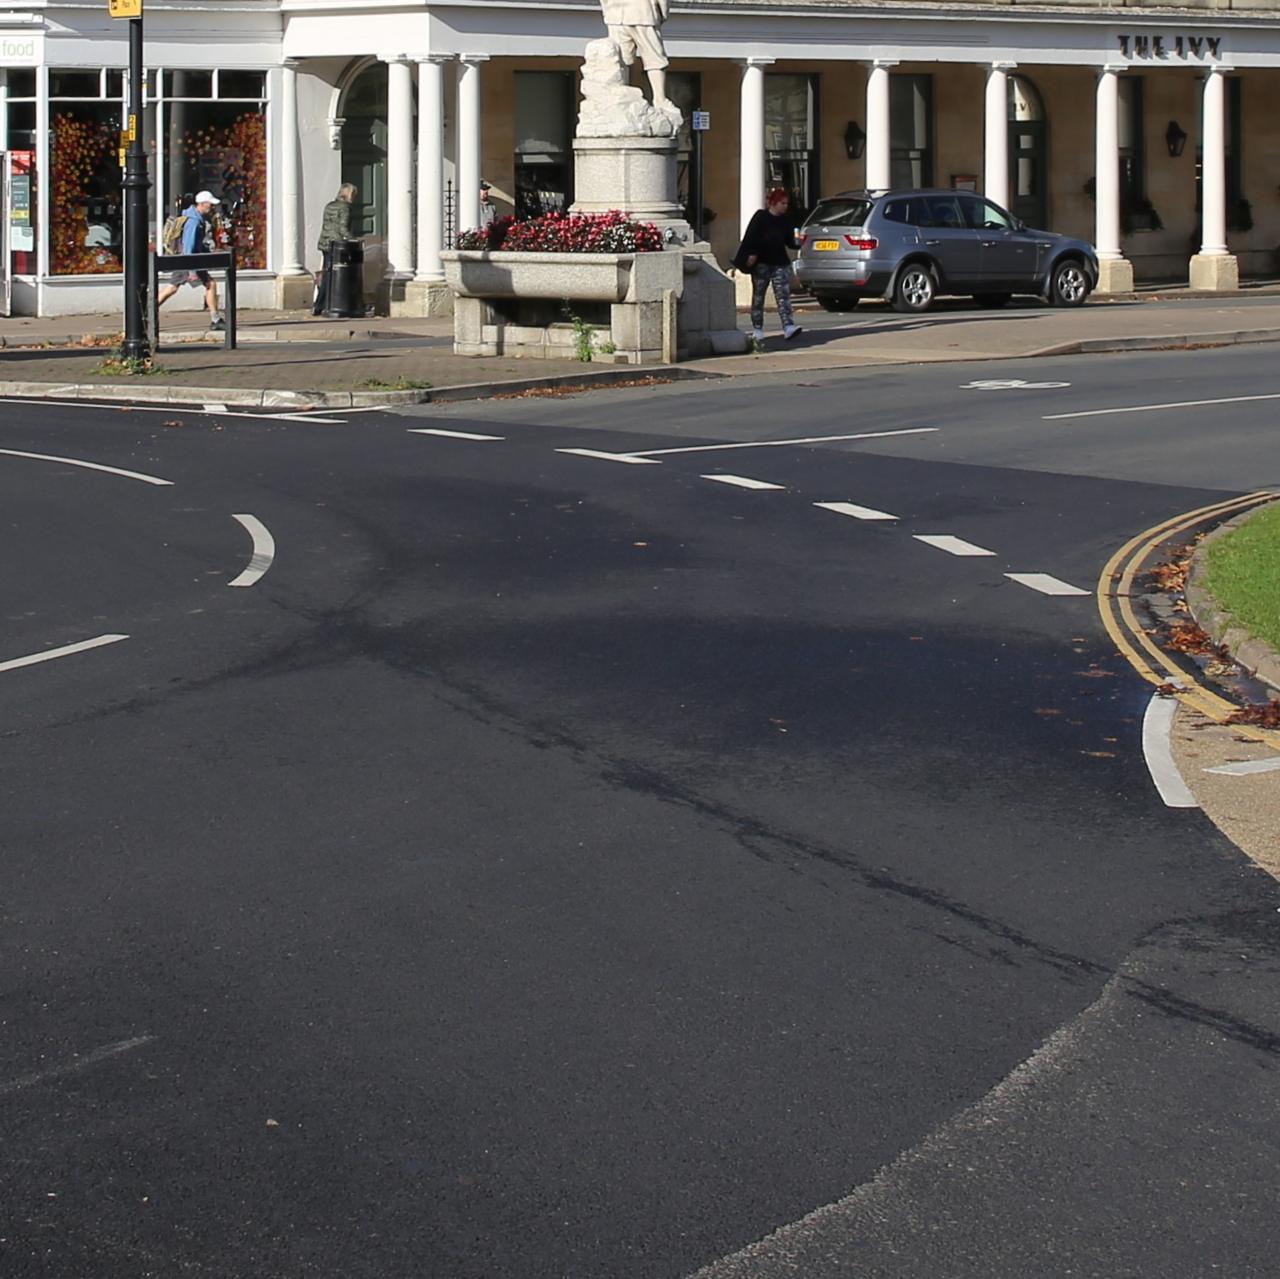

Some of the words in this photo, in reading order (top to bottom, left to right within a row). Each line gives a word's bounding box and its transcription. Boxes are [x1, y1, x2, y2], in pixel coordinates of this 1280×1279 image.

[2, 39, 35, 57] food
[1117, 36, 1163, 57] THE
[1174, 36, 1222, 57] IVY
